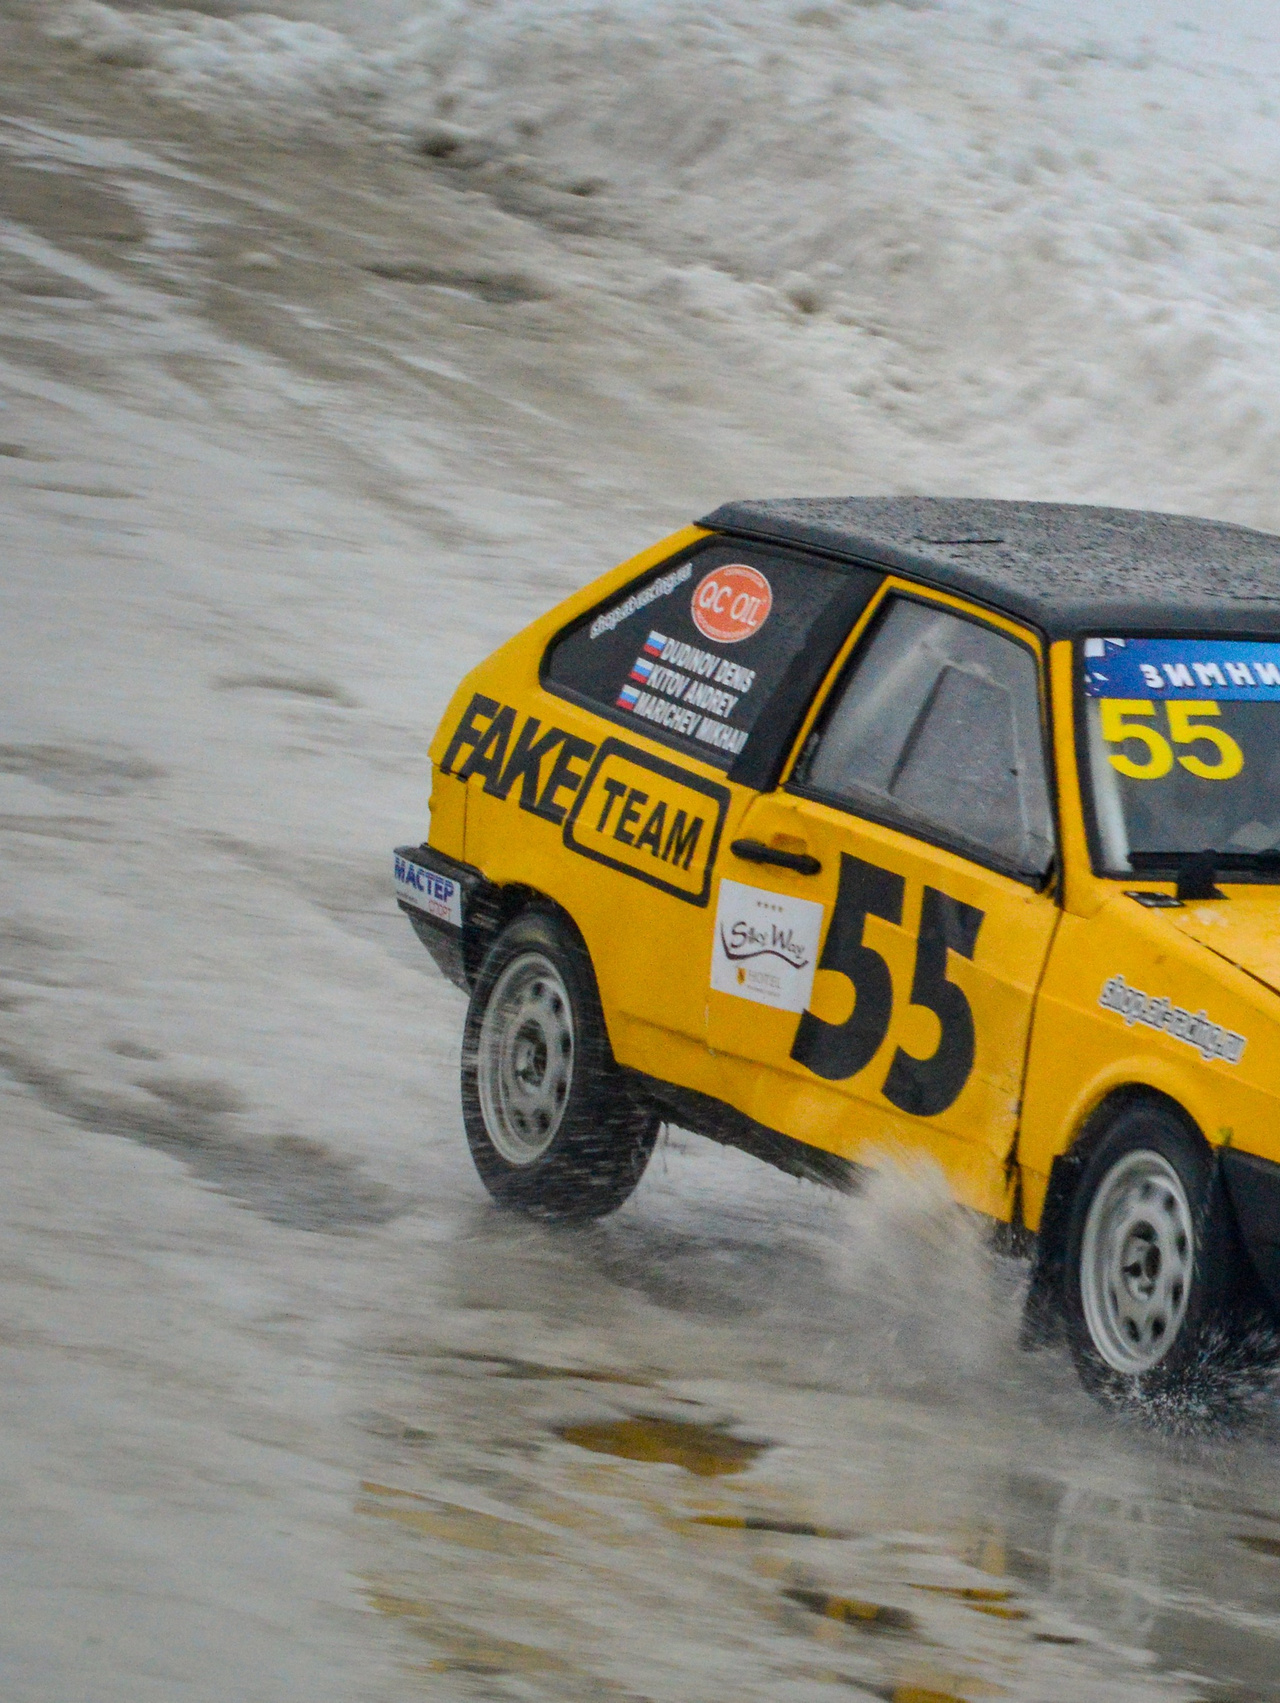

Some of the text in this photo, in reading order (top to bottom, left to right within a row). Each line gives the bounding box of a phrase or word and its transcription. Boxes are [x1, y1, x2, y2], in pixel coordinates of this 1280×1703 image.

[699, 581, 733, 614] QC
[730, 592, 762, 627] OIL
[646, 664, 739, 718] KITOV ANDREY
[714, 659, 756, 693] DENIS
[1100, 698, 1245, 780] 55
[439, 692, 705, 871] FAKE TEAM
[394, 856, 454, 902] МАСТЕР
[772, 924, 805, 959] Way
[789, 851, 986, 1117] 55
